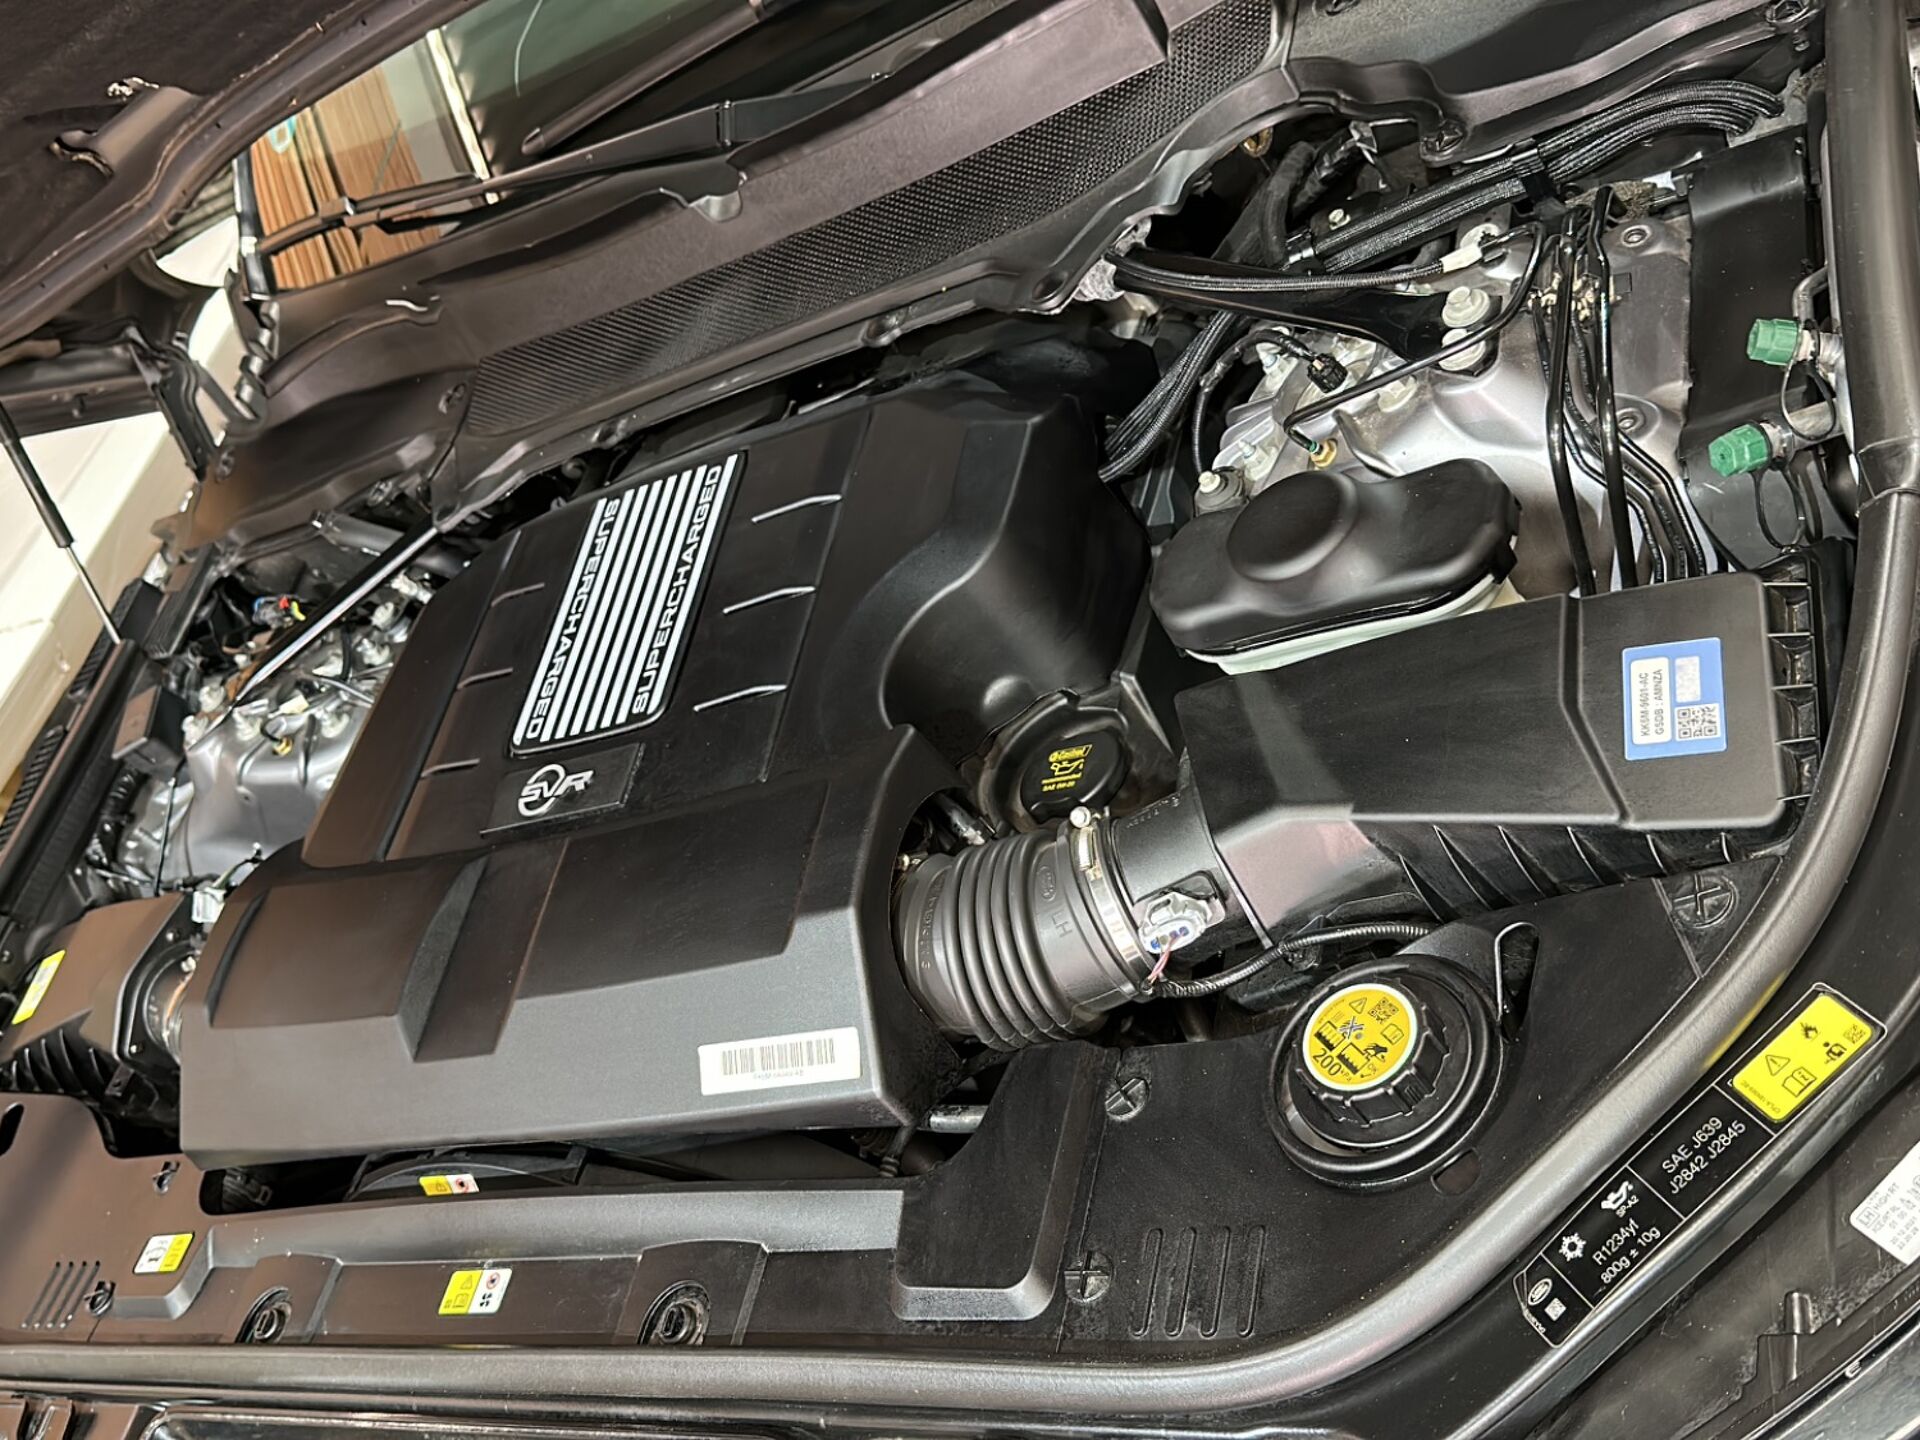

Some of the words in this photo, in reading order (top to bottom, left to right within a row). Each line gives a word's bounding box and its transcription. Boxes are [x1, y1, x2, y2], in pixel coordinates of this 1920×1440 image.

[631, 464, 723, 714] SUPERCHARGED
[526, 497, 621, 740] SUPERCHARGED
[517, 763, 594, 816] SVR
[1313, 1048, 1342, 1076] 200
[1662, 1144, 1691, 1174] SAE
[1689, 1116, 1723, 1158] J639
[1669, 1154, 1709, 1195] J2842
[1708, 1119, 1747, 1160] J2845
[1592, 1220, 1640, 1267] R1234yf
[1600, 1255, 1631, 1285] 800g
[1637, 1226, 1662, 1248] 10g
